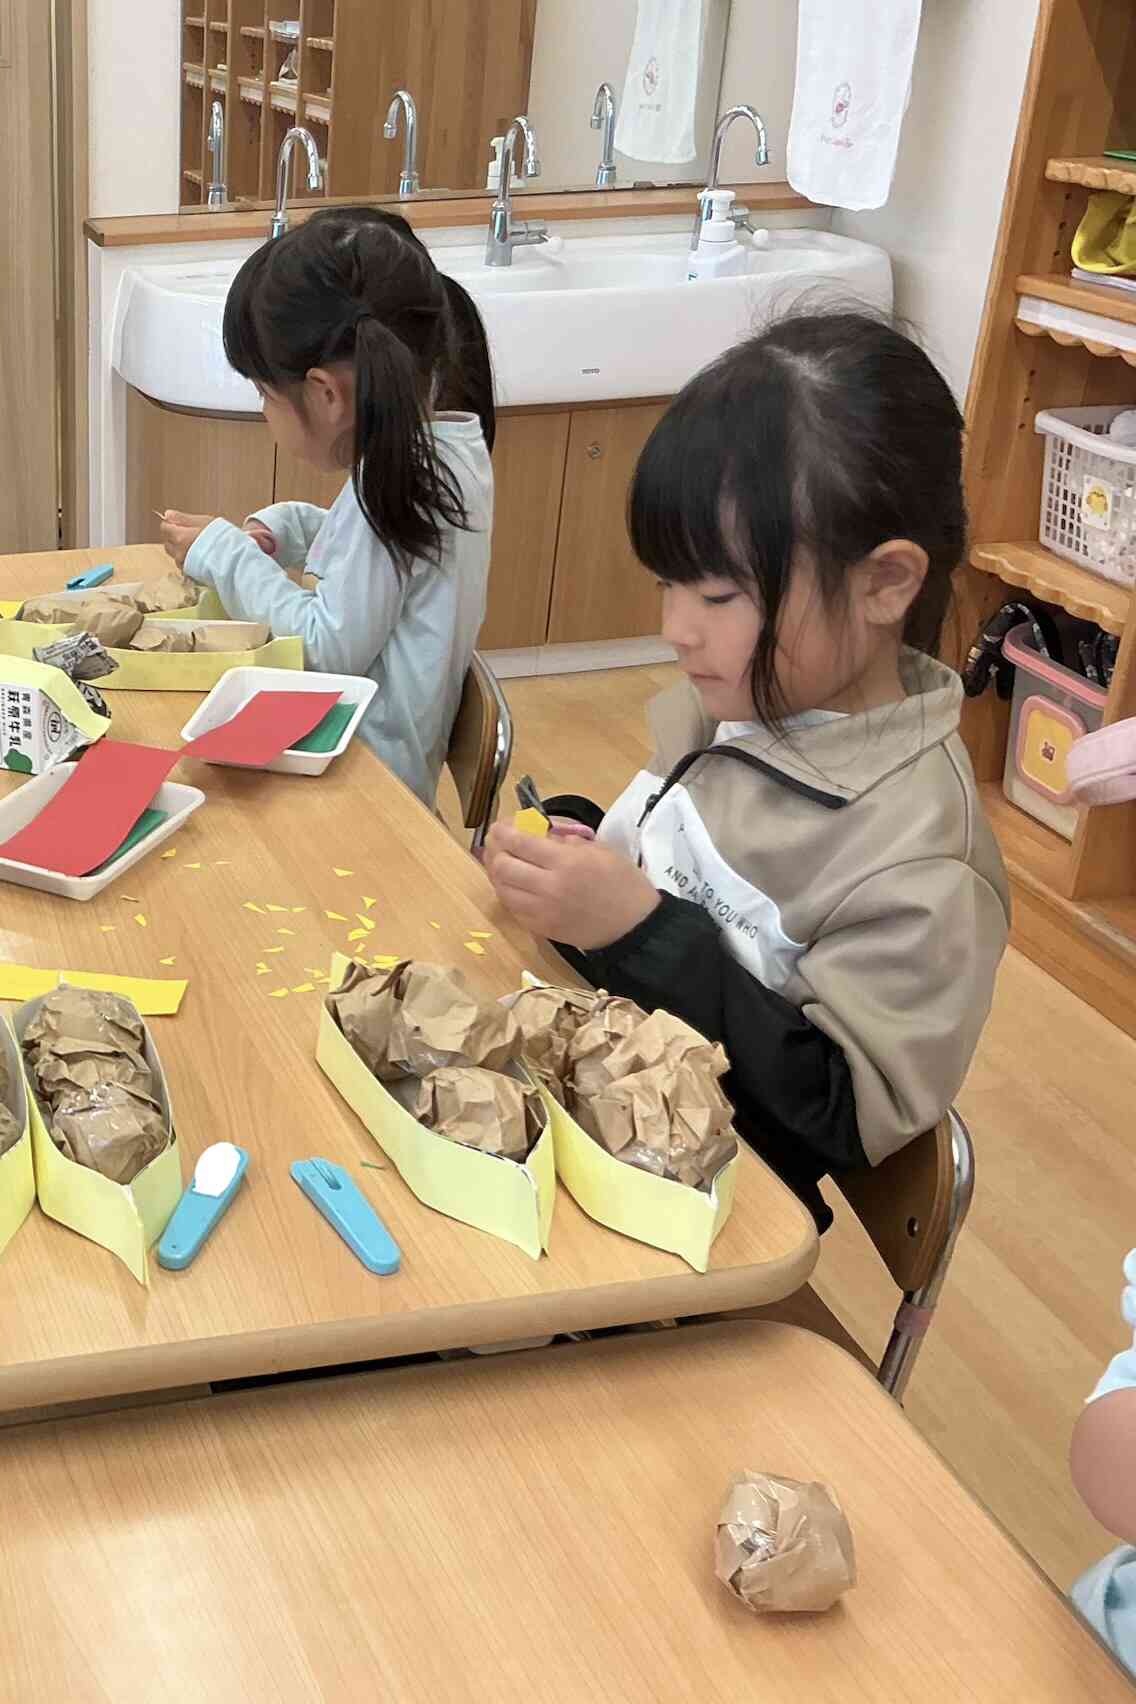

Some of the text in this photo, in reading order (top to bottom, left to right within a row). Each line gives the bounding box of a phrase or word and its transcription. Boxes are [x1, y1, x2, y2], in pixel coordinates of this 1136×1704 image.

[664, 865, 689, 888] AND
[714, 897, 738, 923] YOU
[735, 917, 759, 938] WHO
